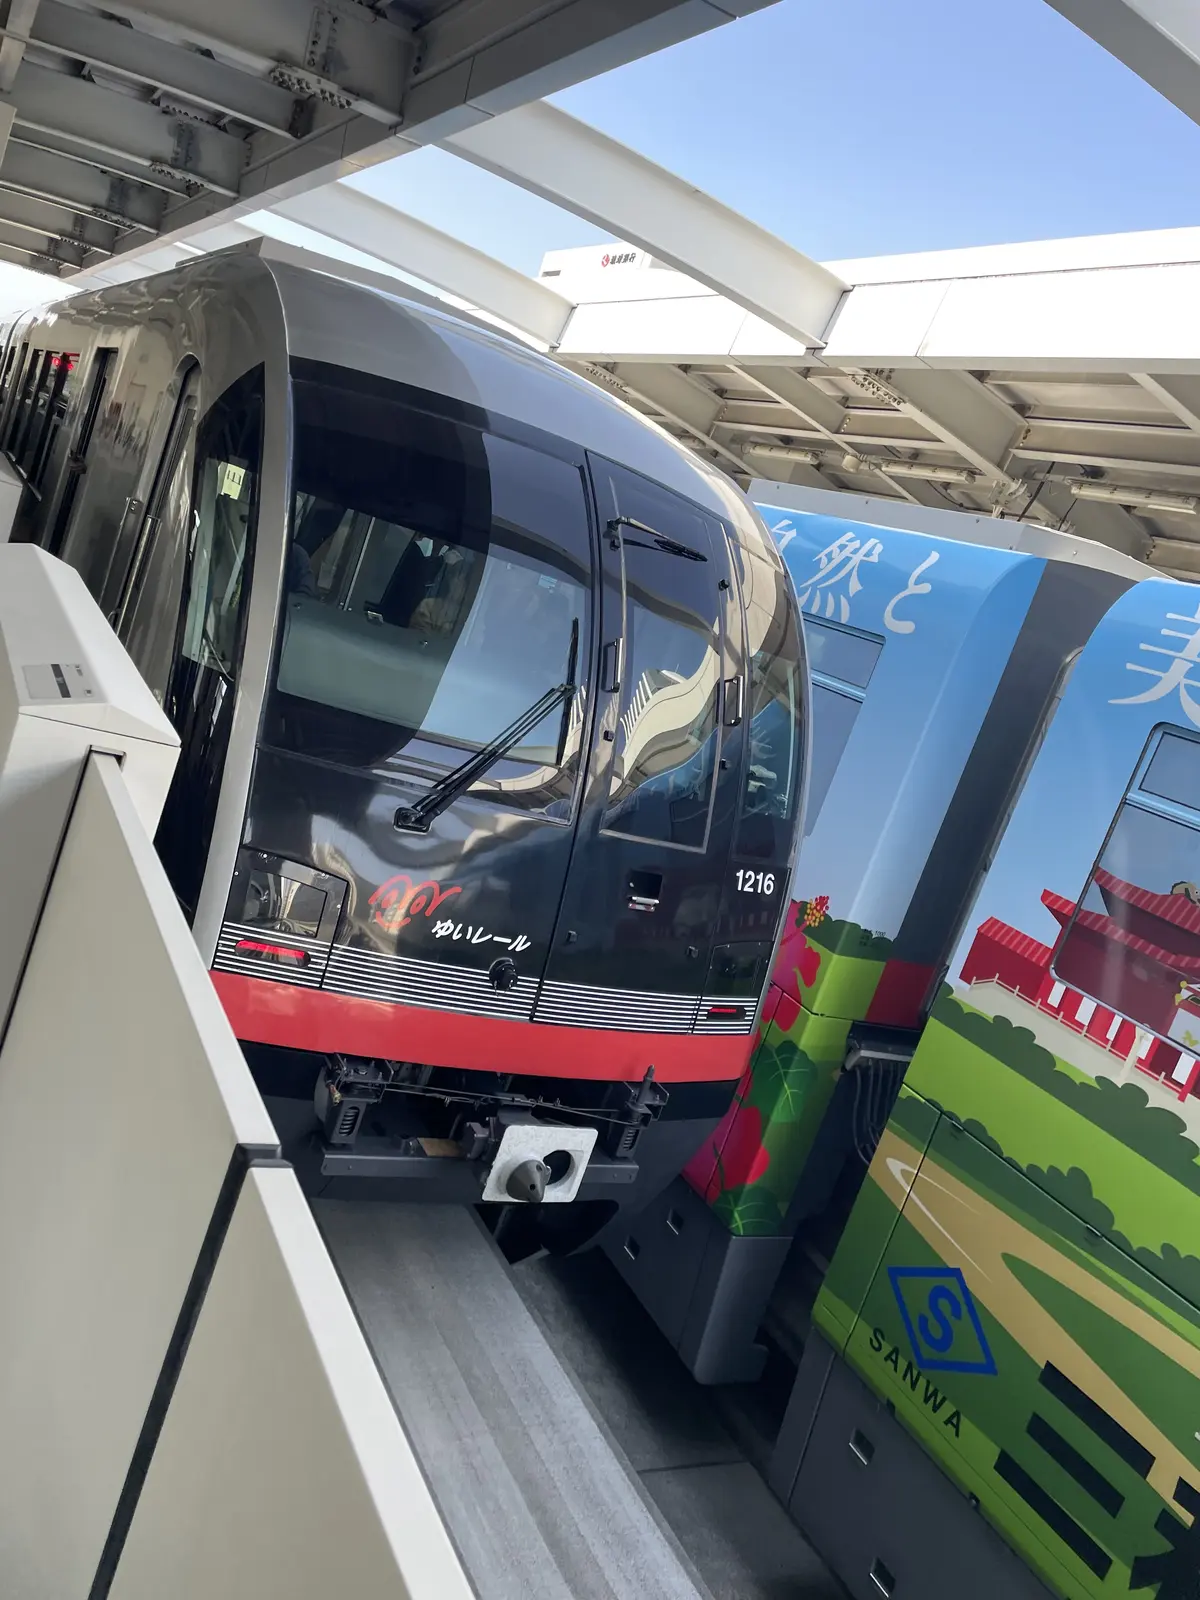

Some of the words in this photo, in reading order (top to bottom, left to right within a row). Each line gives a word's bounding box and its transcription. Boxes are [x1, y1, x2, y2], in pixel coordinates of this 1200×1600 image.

[736, 869, 775, 895] 1216
[431, 919, 532, 952] ゆいレール
[869, 1327, 962, 1438] SANWA
